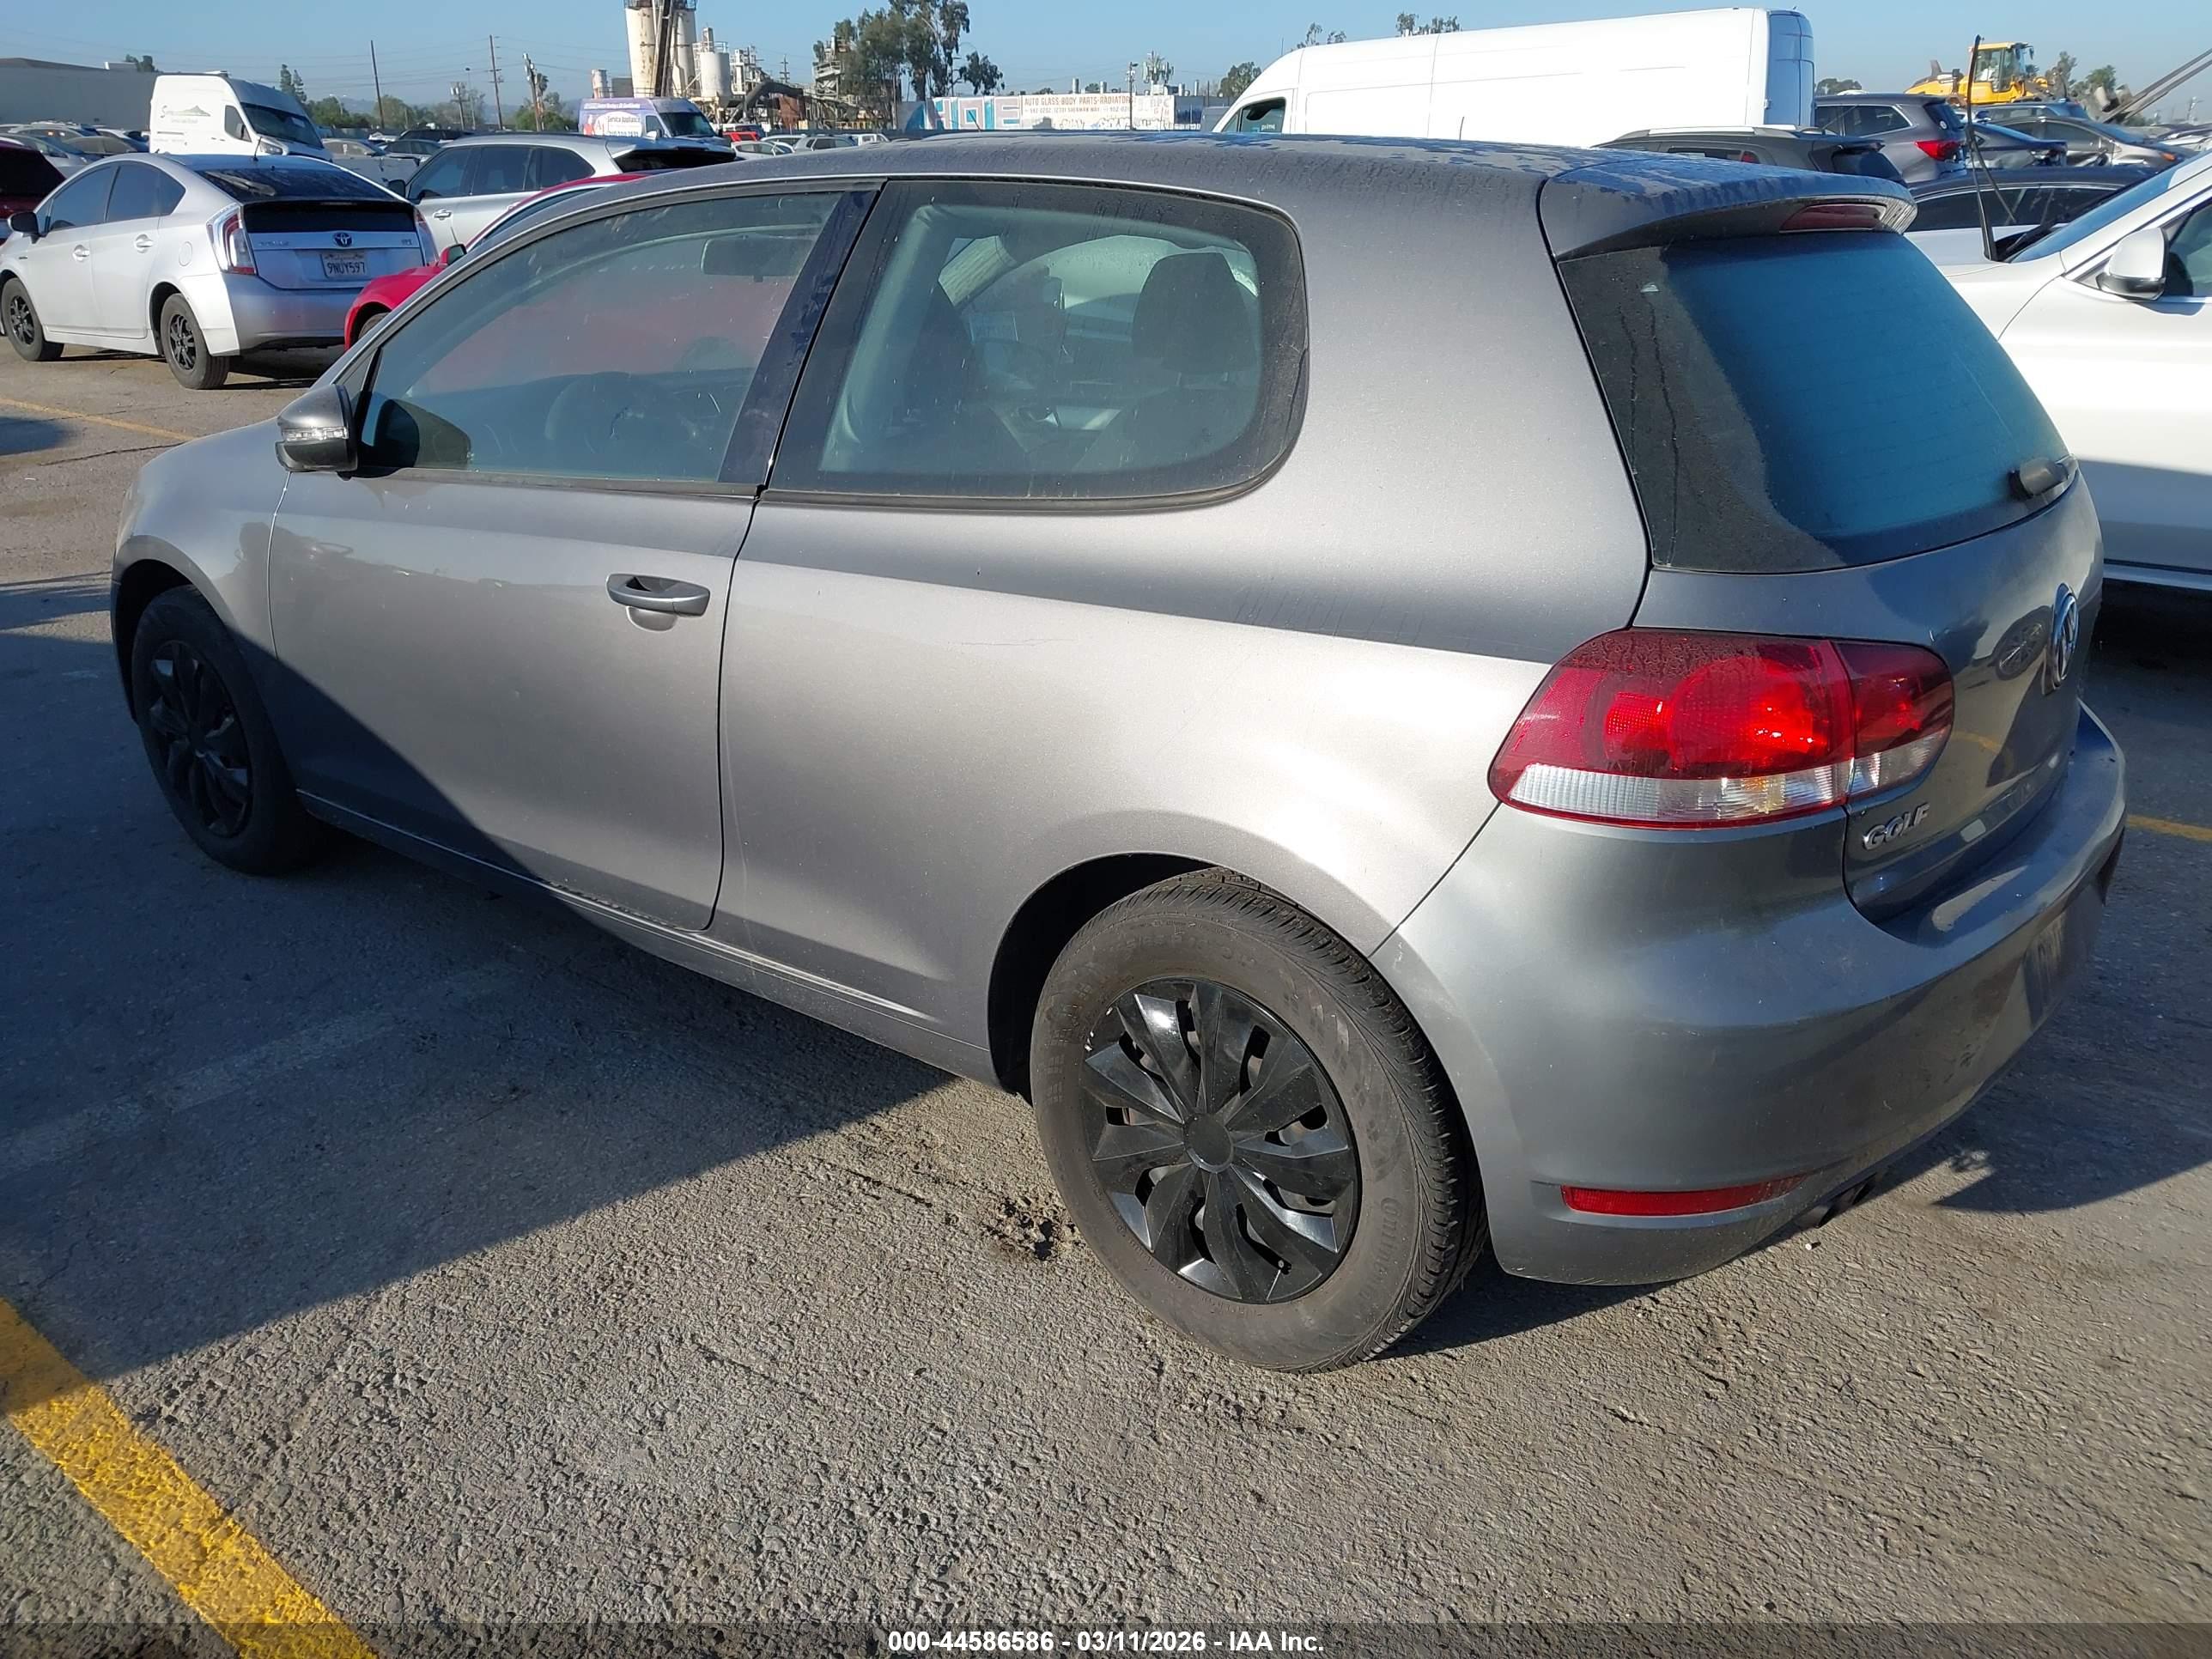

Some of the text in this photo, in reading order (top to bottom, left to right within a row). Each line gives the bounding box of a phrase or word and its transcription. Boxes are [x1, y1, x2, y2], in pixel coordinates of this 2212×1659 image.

[1024, 97, 1039, 106] AUTO
[327, 262, 365, 274] 9NUY597
[1863, 803, 1929, 850] GOLF
